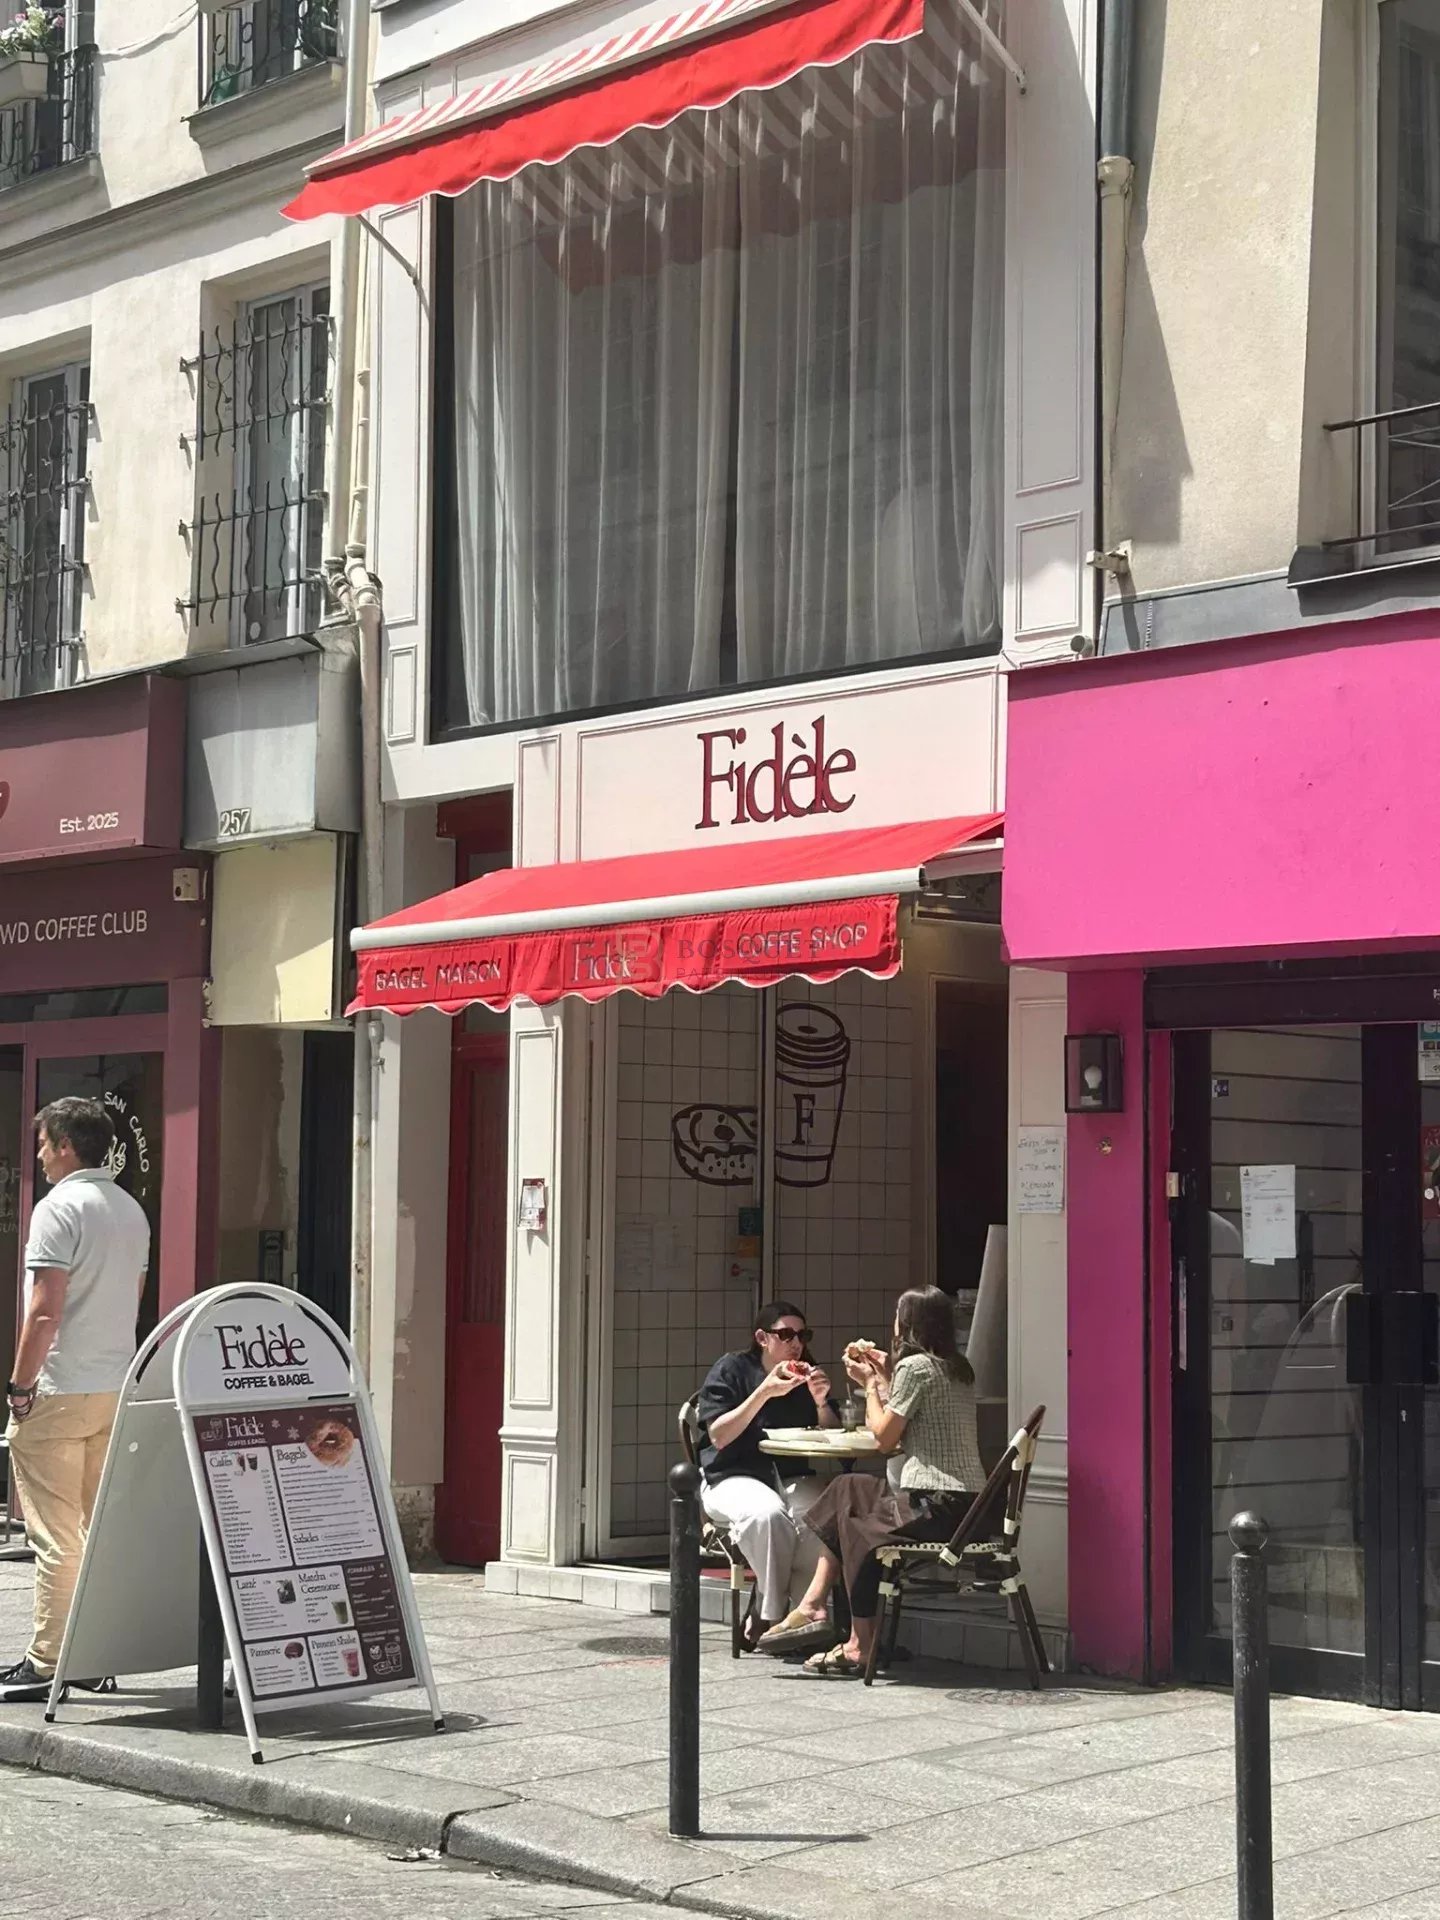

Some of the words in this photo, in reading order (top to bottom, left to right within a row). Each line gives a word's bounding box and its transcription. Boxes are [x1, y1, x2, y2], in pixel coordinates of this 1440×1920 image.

[695, 715, 856, 829] Fidèle
[60, 818, 85, 834] Est.
[88, 812, 119, 830] 2025
[219, 808, 251, 836] 257
[35, 914, 98, 942] COFFEE
[101, 909, 148, 935] CLUB
[811, 922, 868, 950] SHOP
[375, 966, 428, 990] BAGEL
[436, 958, 502, 985] MAISON
[104, 1091, 127, 1114] SAN
[129, 1115, 150, 1173] CARLO
[214, 1322, 308, 1371] Fidèle
[224, 1375, 267, 1390] COFFEE
[268, 1374, 277, 1387] &
[277, 1372, 314, 1387] BAGEL
[225, 1415, 265, 1439] Fidèle
